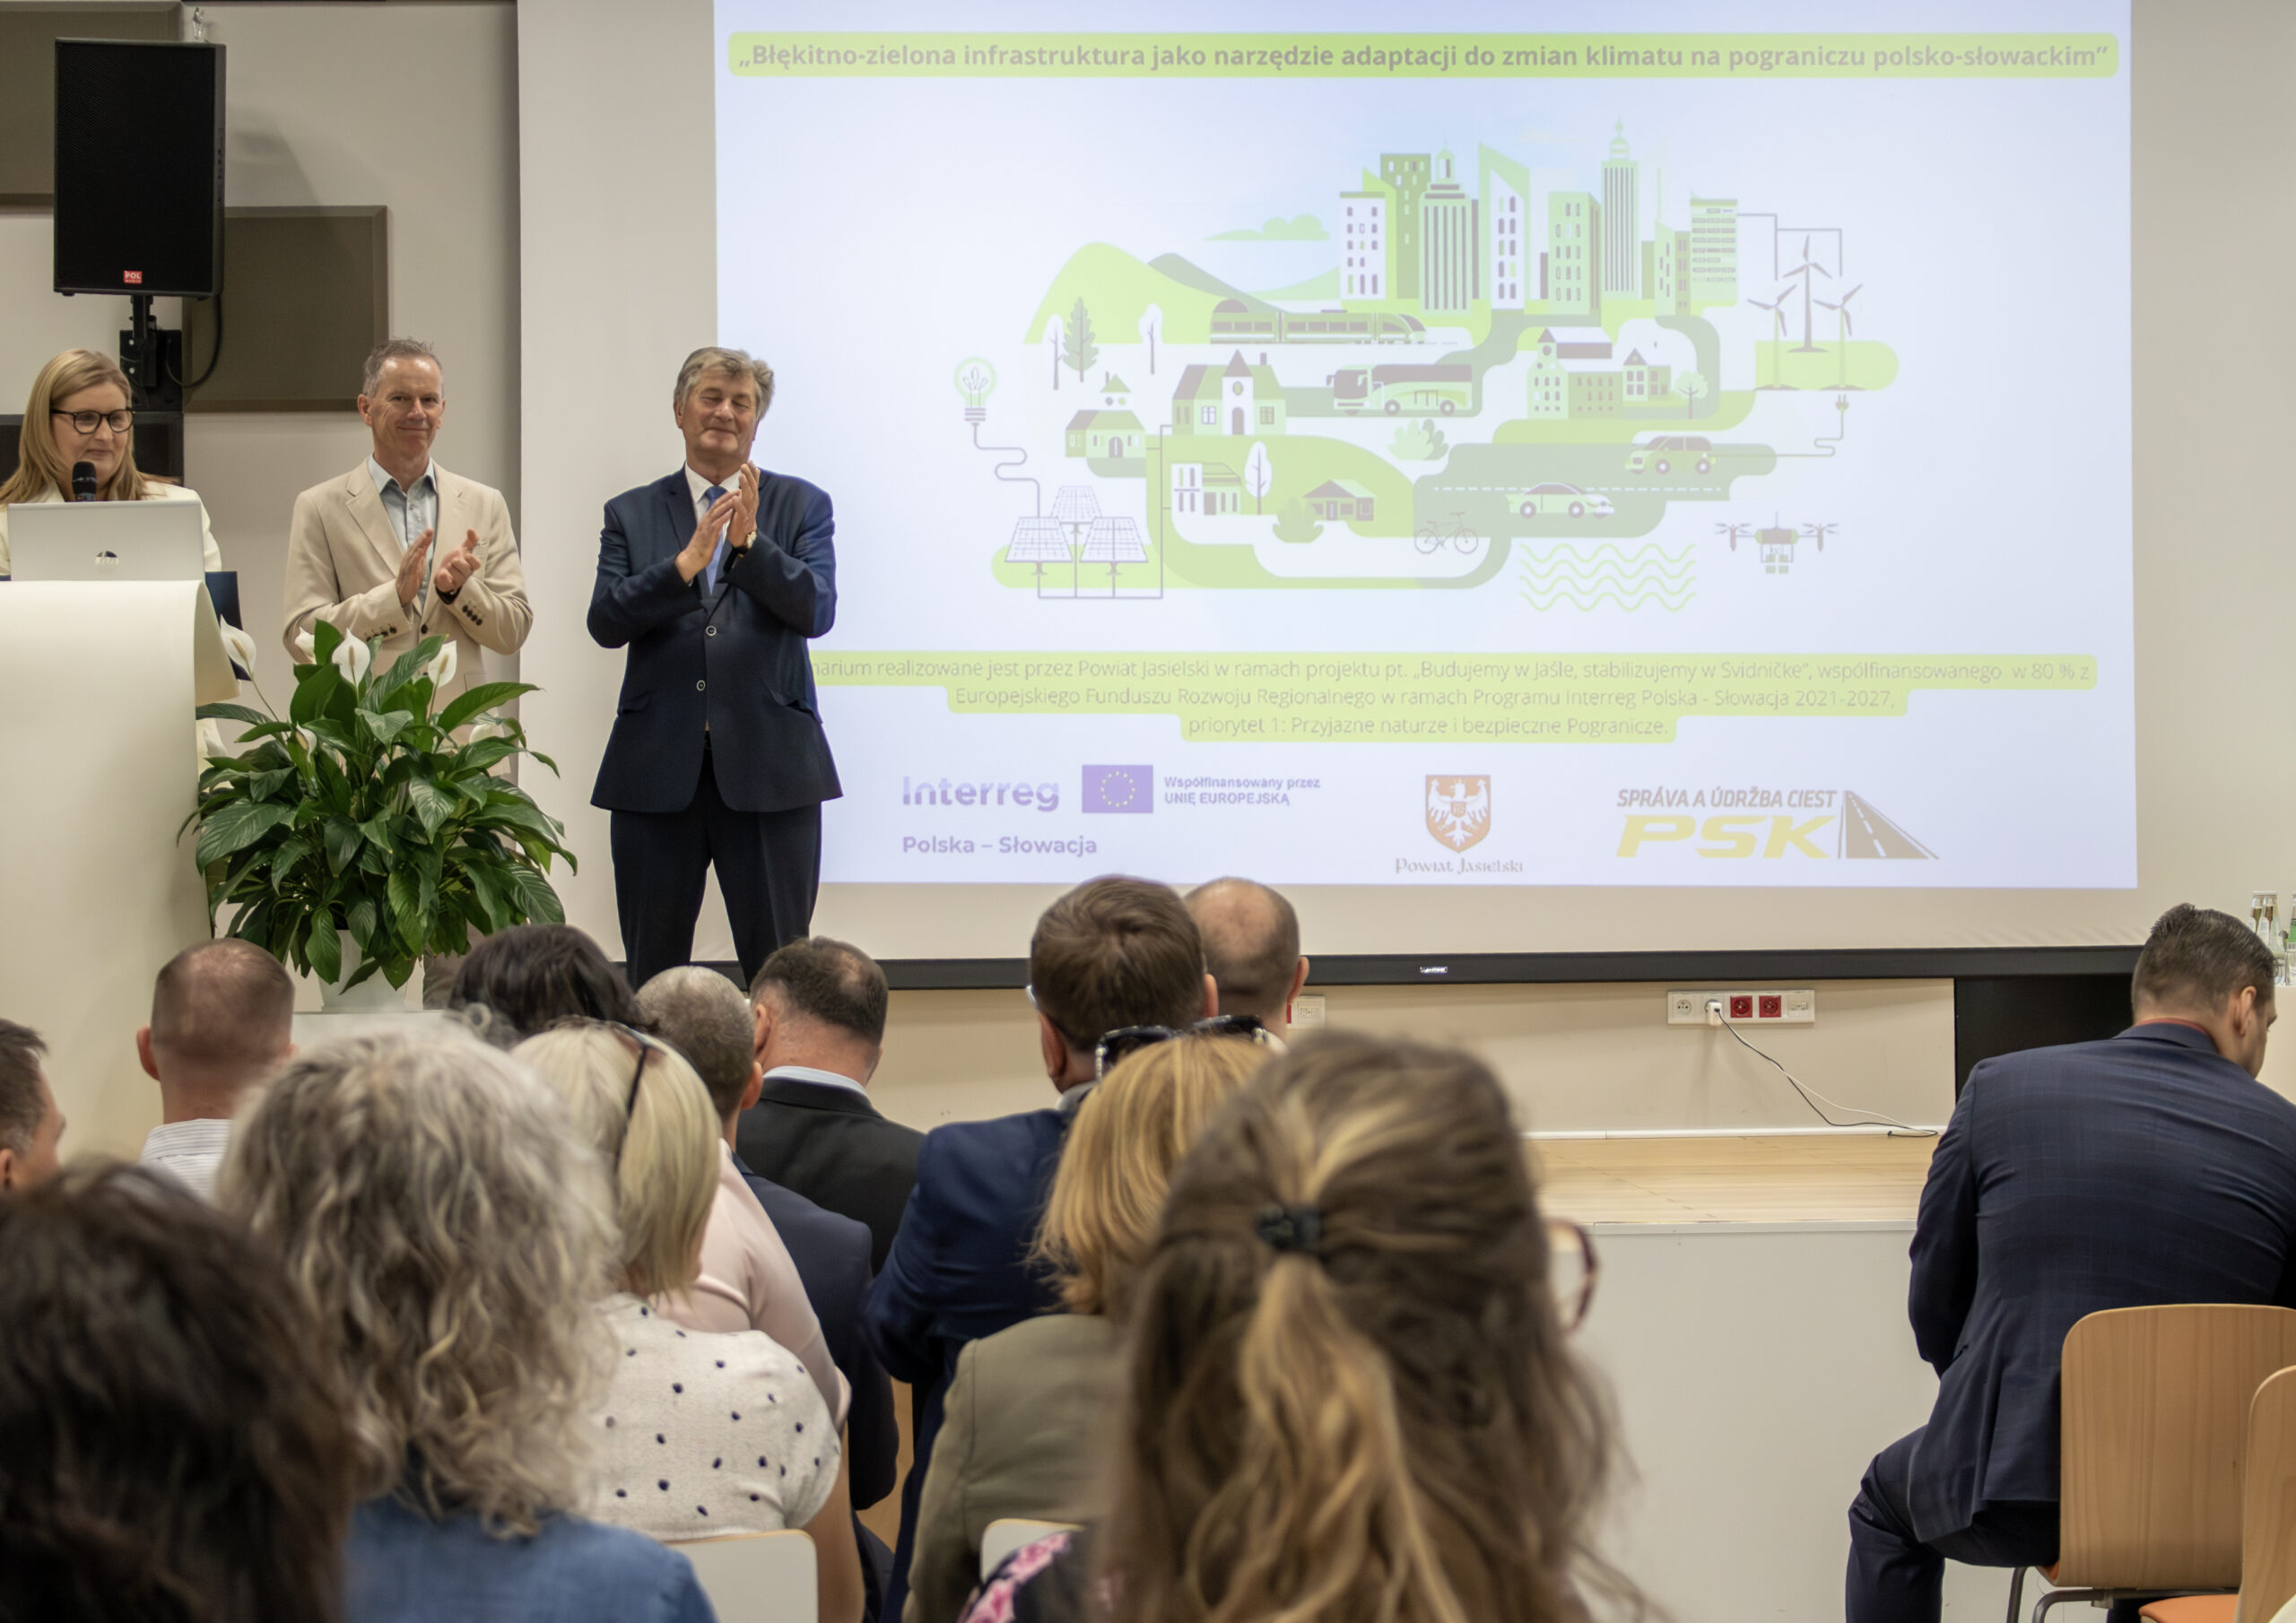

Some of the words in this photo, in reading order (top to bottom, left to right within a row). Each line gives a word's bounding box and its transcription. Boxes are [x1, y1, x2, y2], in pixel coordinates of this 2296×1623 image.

[964, 45, 1144, 65] infrastruktura
[1152, 45, 1206, 72] jako
[1214, 45, 1334, 72] narzędzie
[1342, 45, 1457, 72] adaptacji
[1465, 45, 1495, 66] do
[1502, 45, 1577, 66] zmian
[1586, 45, 1683, 66] klimatu
[1692, 50, 1720, 66] na
[1729, 45, 1865, 72] pograniczu
[877, 659, 983, 677] realizowane
[986, 660, 1020, 681] jest
[1024, 664, 1074, 681] przez
[1078, 660, 1137, 677] Powiat
[1141, 660, 1209, 680] Jasielski
[1213, 664, 1230, 677] w
[1235, 660, 1300, 678] ramach
[1306, 661, 1380, 682] projektu
[1385, 664, 1408, 682] pt.
[1515, 664, 1530, 678] w
[1532, 661, 1578, 681] Jaśle,
[1583, 662, 1697, 683] stabilizujemy
[1701, 665, 1717, 679] w
[2012, 667, 2027, 680] w
[2031, 663, 2054, 680] 80
[2059, 664, 2075, 680] %
[2080, 667, 2089, 681] z
[956, 688, 1081, 708] Europejskiego
[1086, 687, 1171, 705] Funduszu
[1178, 689, 1251, 708] Rozwoju
[1257, 689, 1376, 709] Regionalnego
[1381, 692, 1396, 705] w
[1401, 689, 1467, 706] ramach
[1474, 689, 1561, 709] Programu
[1566, 690, 1637, 710] Interreg
[1642, 690, 1697, 707] Polska
[1715, 690, 1789, 710] Słowacja
[1795, 690, 1894, 708] 2021-2027,
[1188, 716, 1265, 737] priorytet
[1272, 717, 1286, 733] 1:
[1292, 716, 1375, 738] Przyjazne
[1380, 718, 1448, 734] naturze
[1463, 717, 1561, 738] bezpieczne
[1568, 717, 1668, 738] Pogranicze.
[902, 776, 1060, 812] Interreg
[1164, 777, 1283, 790] Współfinansowany
[1287, 779, 1320, 791] przez
[1164, 792, 1196, 806] UNIĘ
[1200, 792, 1291, 807] EUROPEJSKĄ
[1616, 786, 1689, 808] SPRÁVA
[1692, 790, 1706, 808] A
[1710, 786, 1783, 808] ÚDRŽBA
[1787, 790, 1837, 808] CIEST
[902, 835, 975, 854] Polska
[999, 835, 1098, 858] Słowacja
[1616, 815, 1837, 859] PSK
[1396, 857, 1454, 874] Powiat
[1457, 857, 1523, 875] Jasielski
